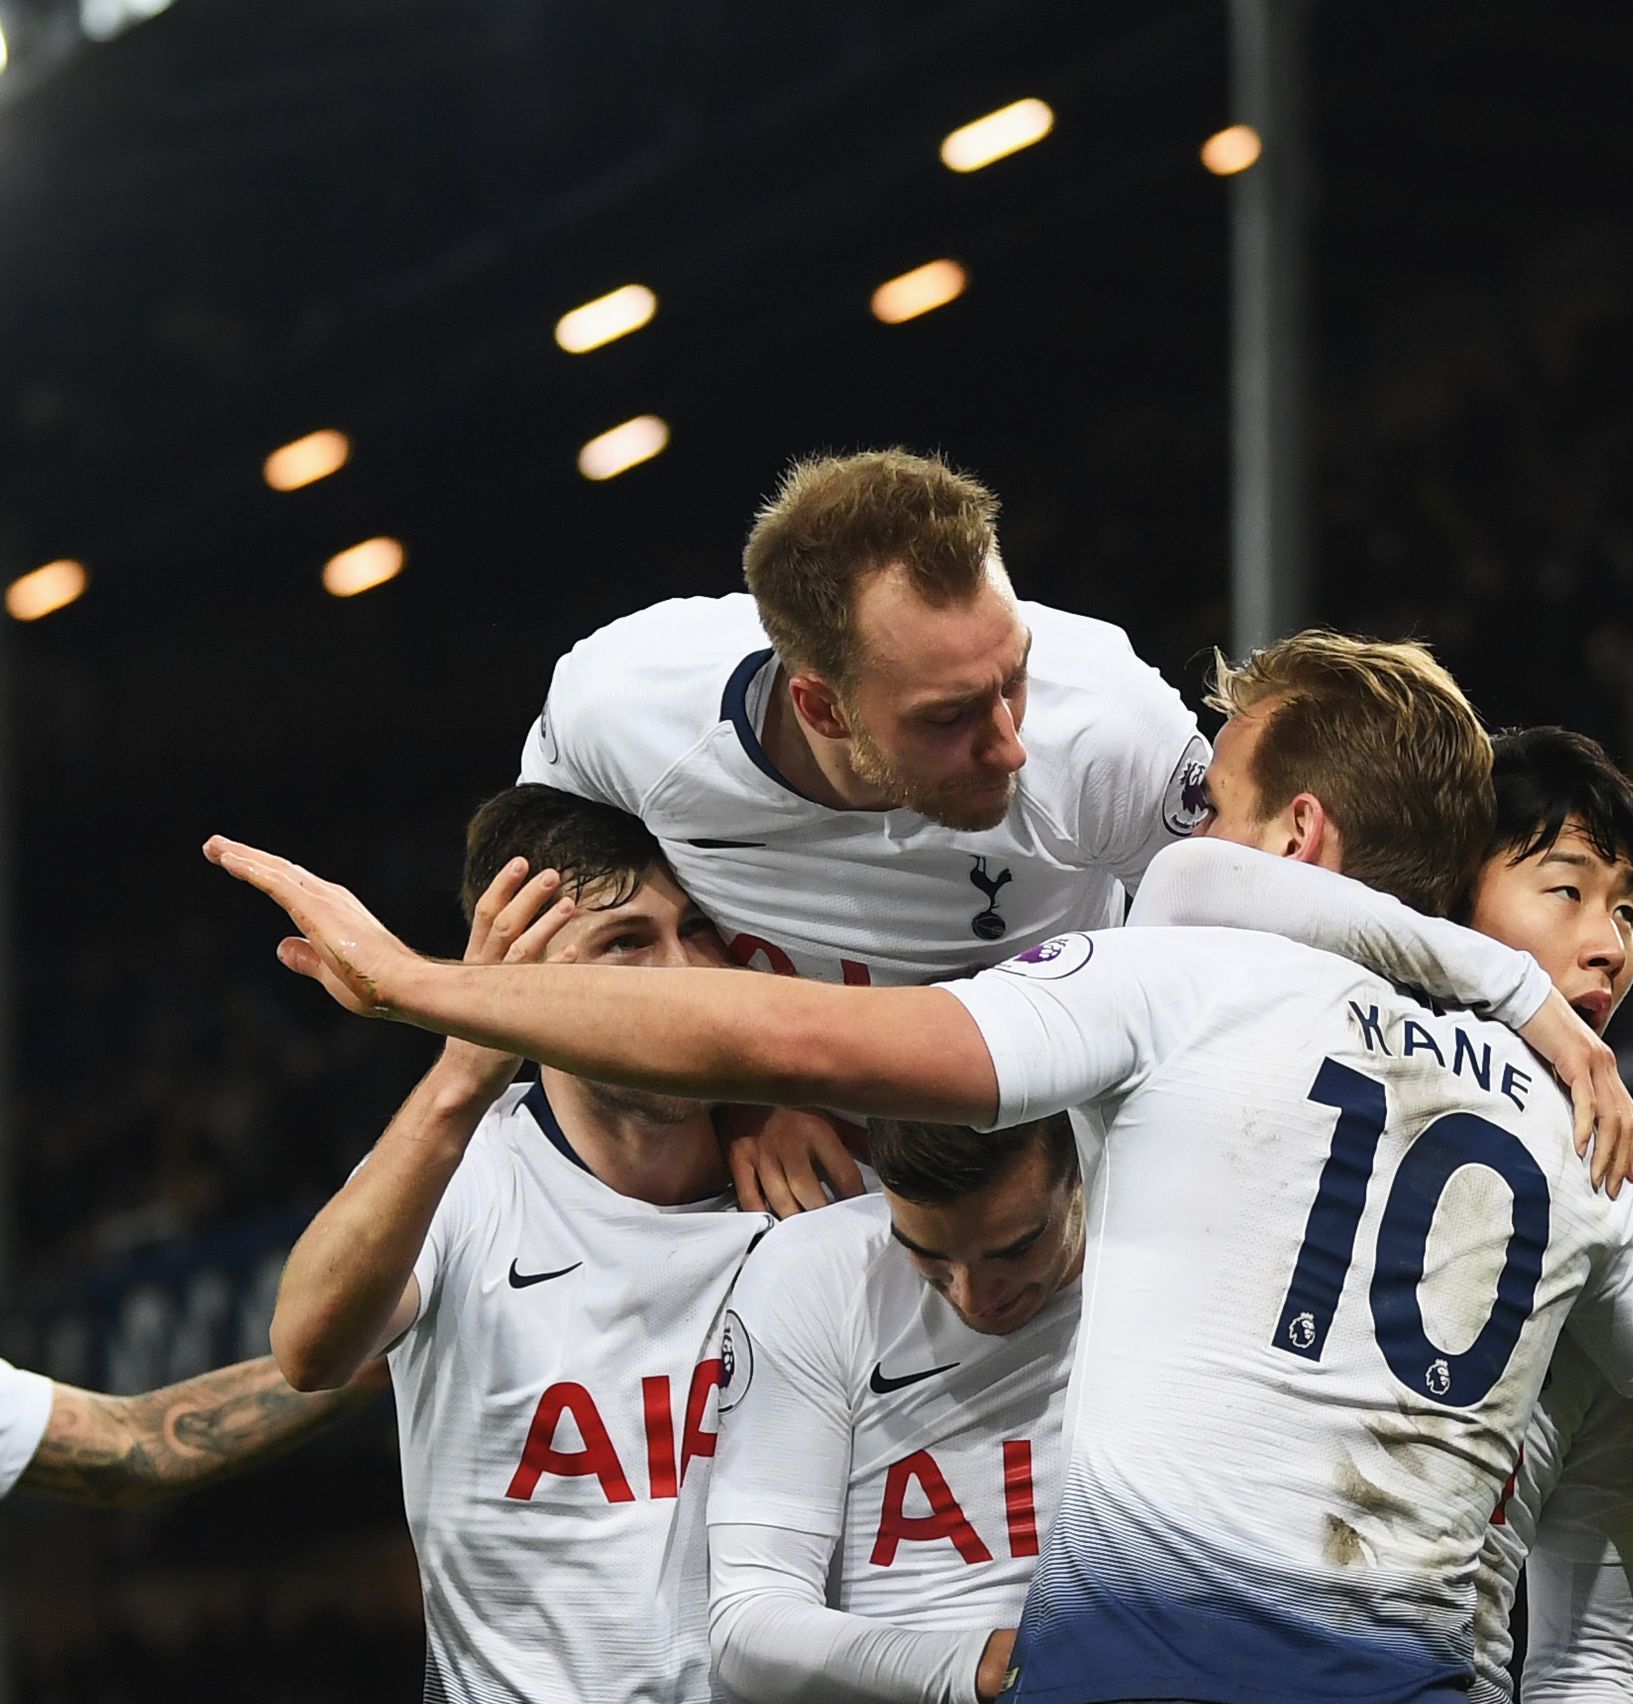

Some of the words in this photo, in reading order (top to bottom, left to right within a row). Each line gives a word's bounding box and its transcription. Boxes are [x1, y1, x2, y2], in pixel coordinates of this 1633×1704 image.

[1348, 1000, 1532, 1112] KANE
[1271, 1056, 1551, 1408] 10
[869, 1439, 1040, 1568] AI
